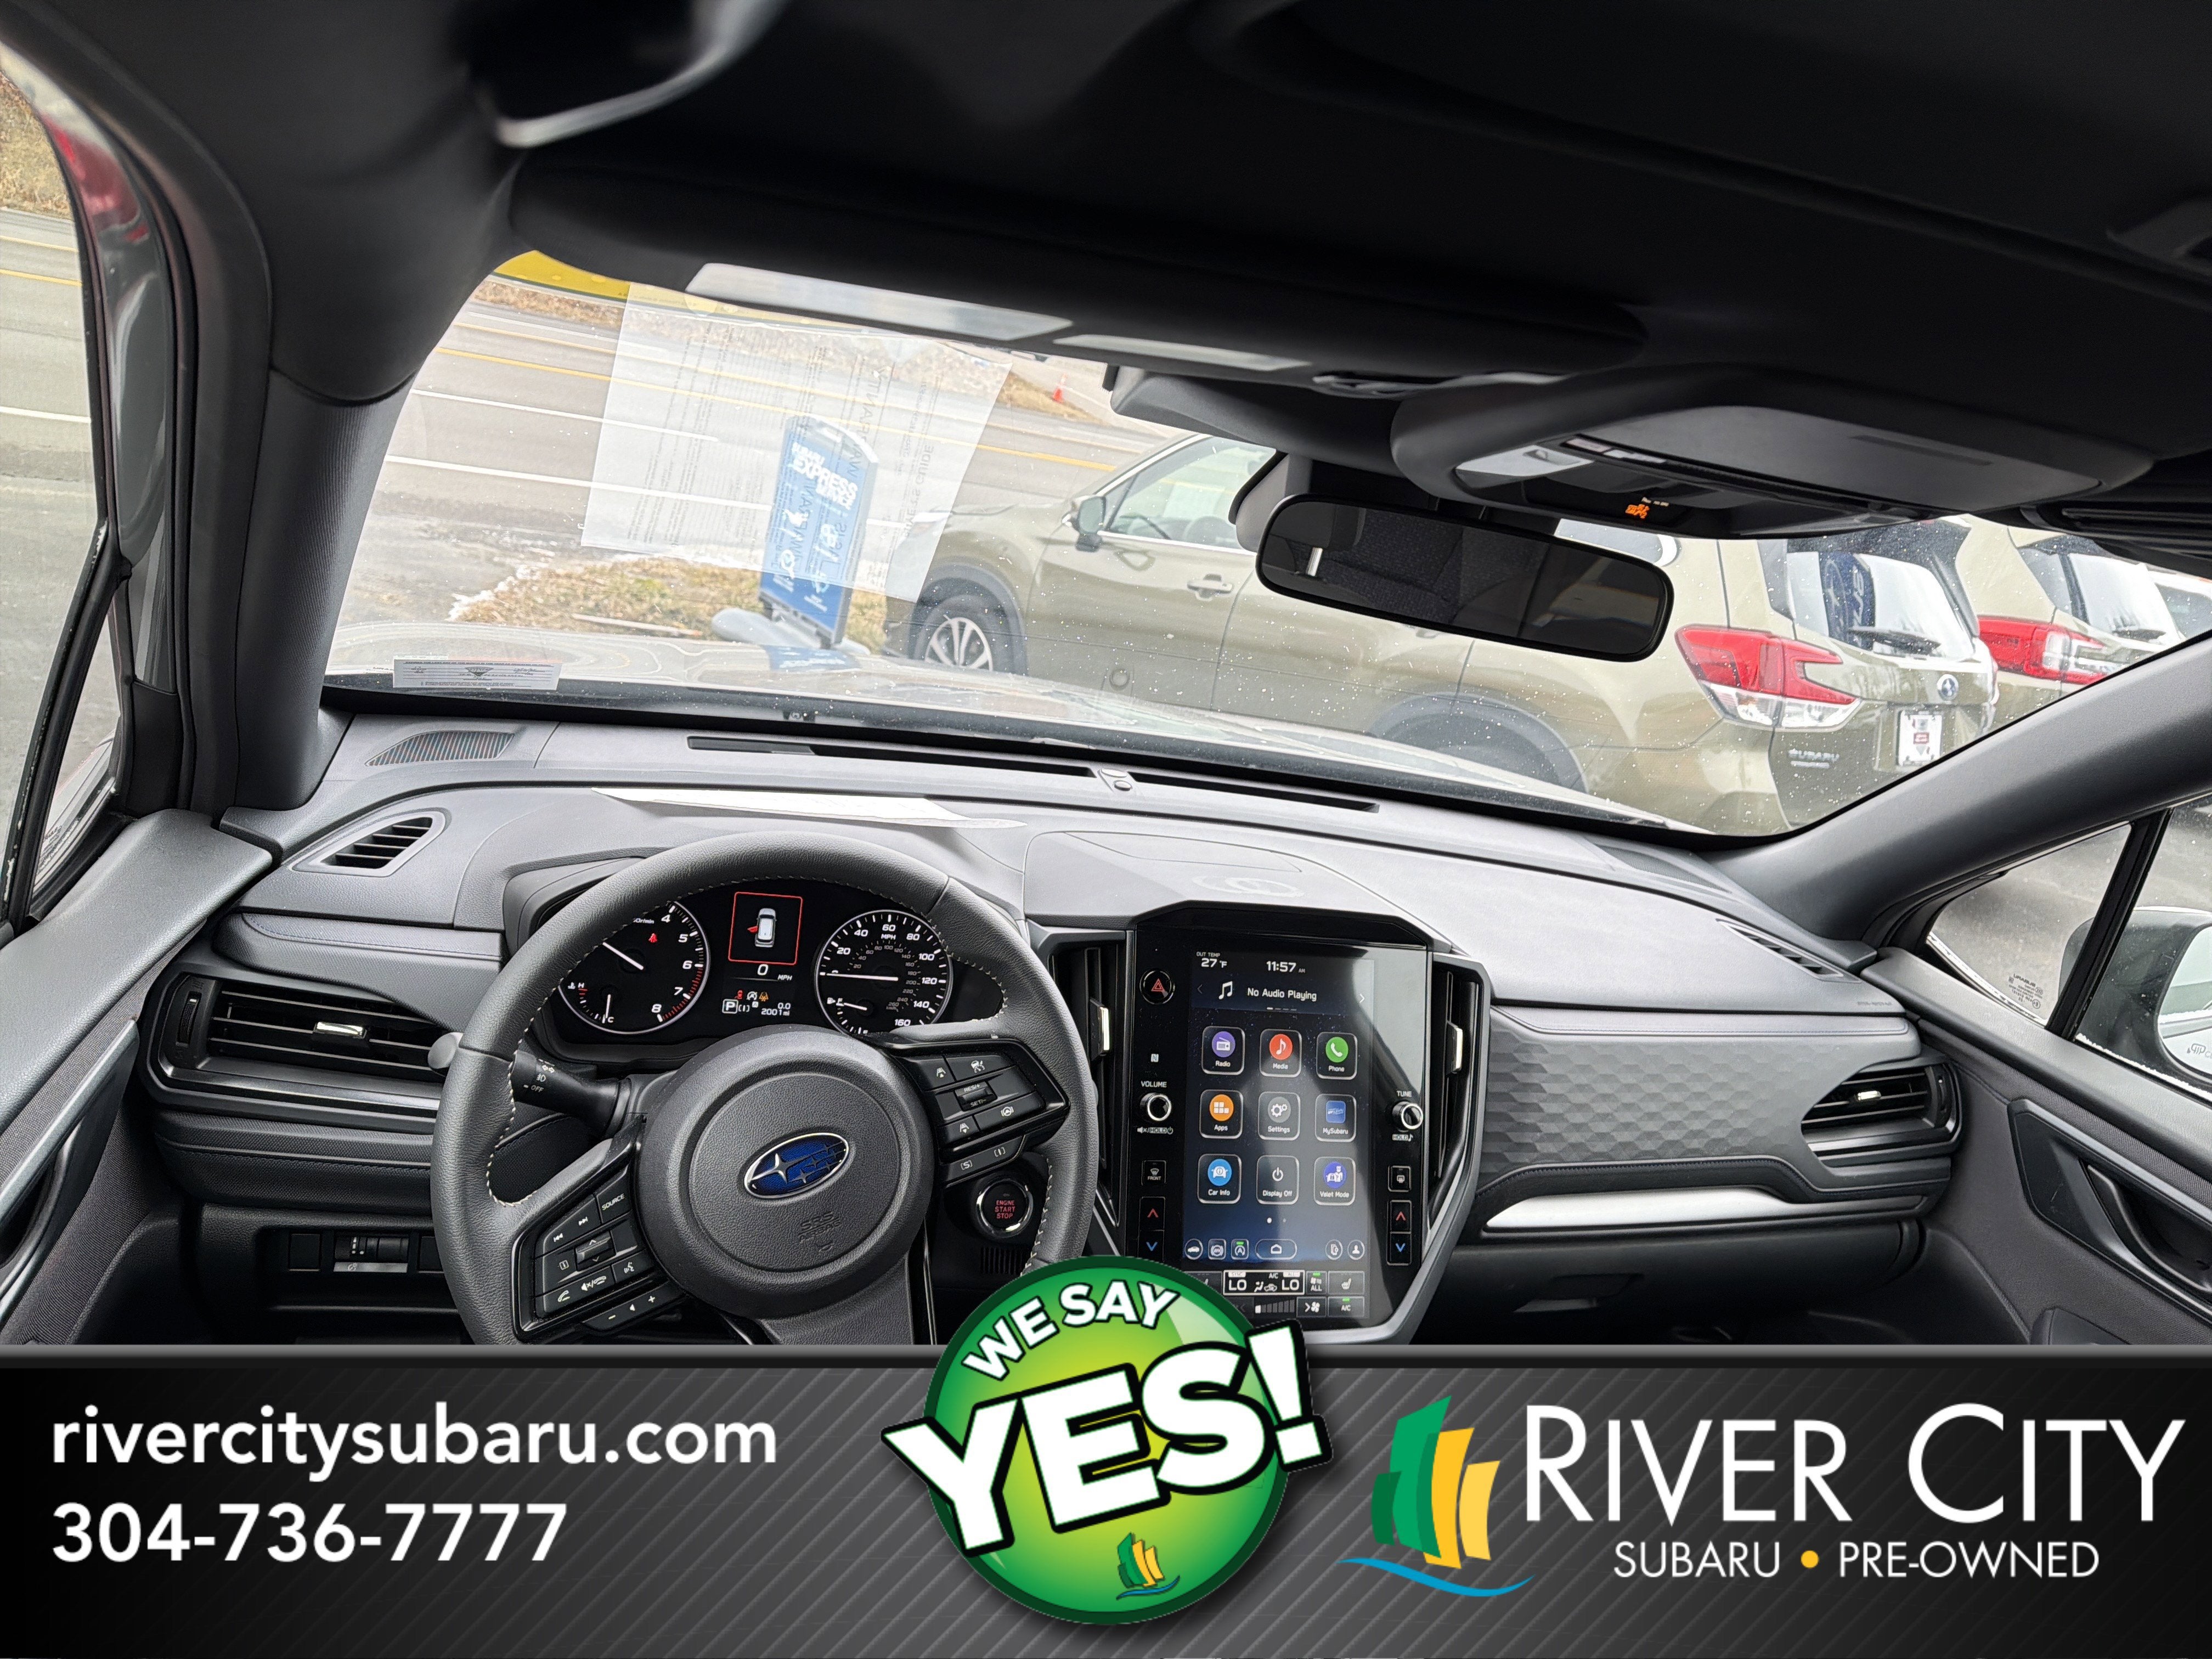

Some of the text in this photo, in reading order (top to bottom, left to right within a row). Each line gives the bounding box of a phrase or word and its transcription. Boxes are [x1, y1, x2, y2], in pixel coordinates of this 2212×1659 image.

[788, 459, 857, 500] EXPRESS
[661, 915, 670, 923] 4
[678, 934, 688, 943] 5
[682, 961, 692, 969] 6
[1201, 958, 1217, 967] 27
[1267, 961, 1296, 972] 11:57
[757, 964, 769, 975] 0
[674, 986, 683, 996] 7
[1248, 988, 1317, 1002] No Audio Playing
[651, 1004, 662, 1013] 8
[726, 1002, 735, 1011] P
[602, 1193, 625, 1210] SOURCE
[1229, 1279, 1246, 1291] LO
[1282, 1279, 1299, 1291] LO
